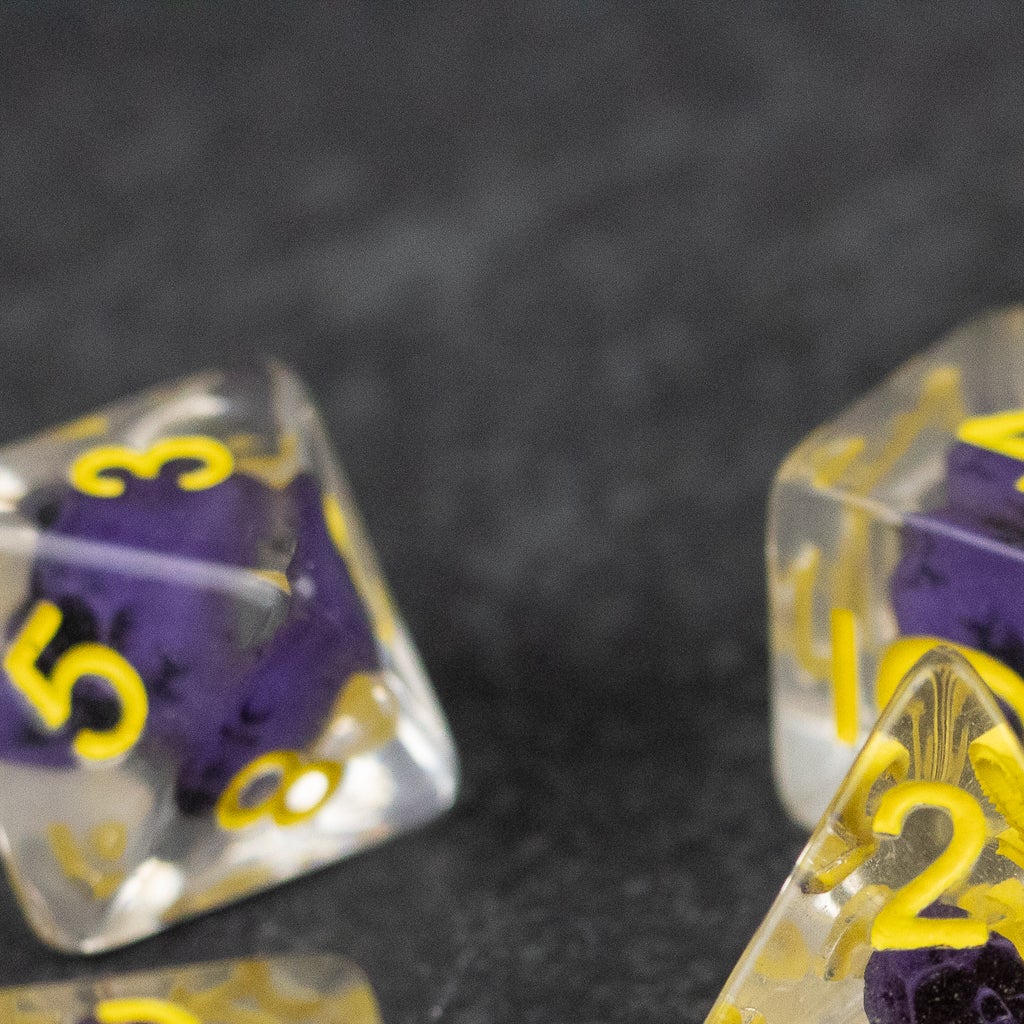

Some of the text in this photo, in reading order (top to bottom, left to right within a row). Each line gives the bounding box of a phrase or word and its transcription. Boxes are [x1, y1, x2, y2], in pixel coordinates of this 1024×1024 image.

[72, 436, 235, 498] 3
[3, 600, 149, 761] 5
[873, 781, 986, 950] 2
